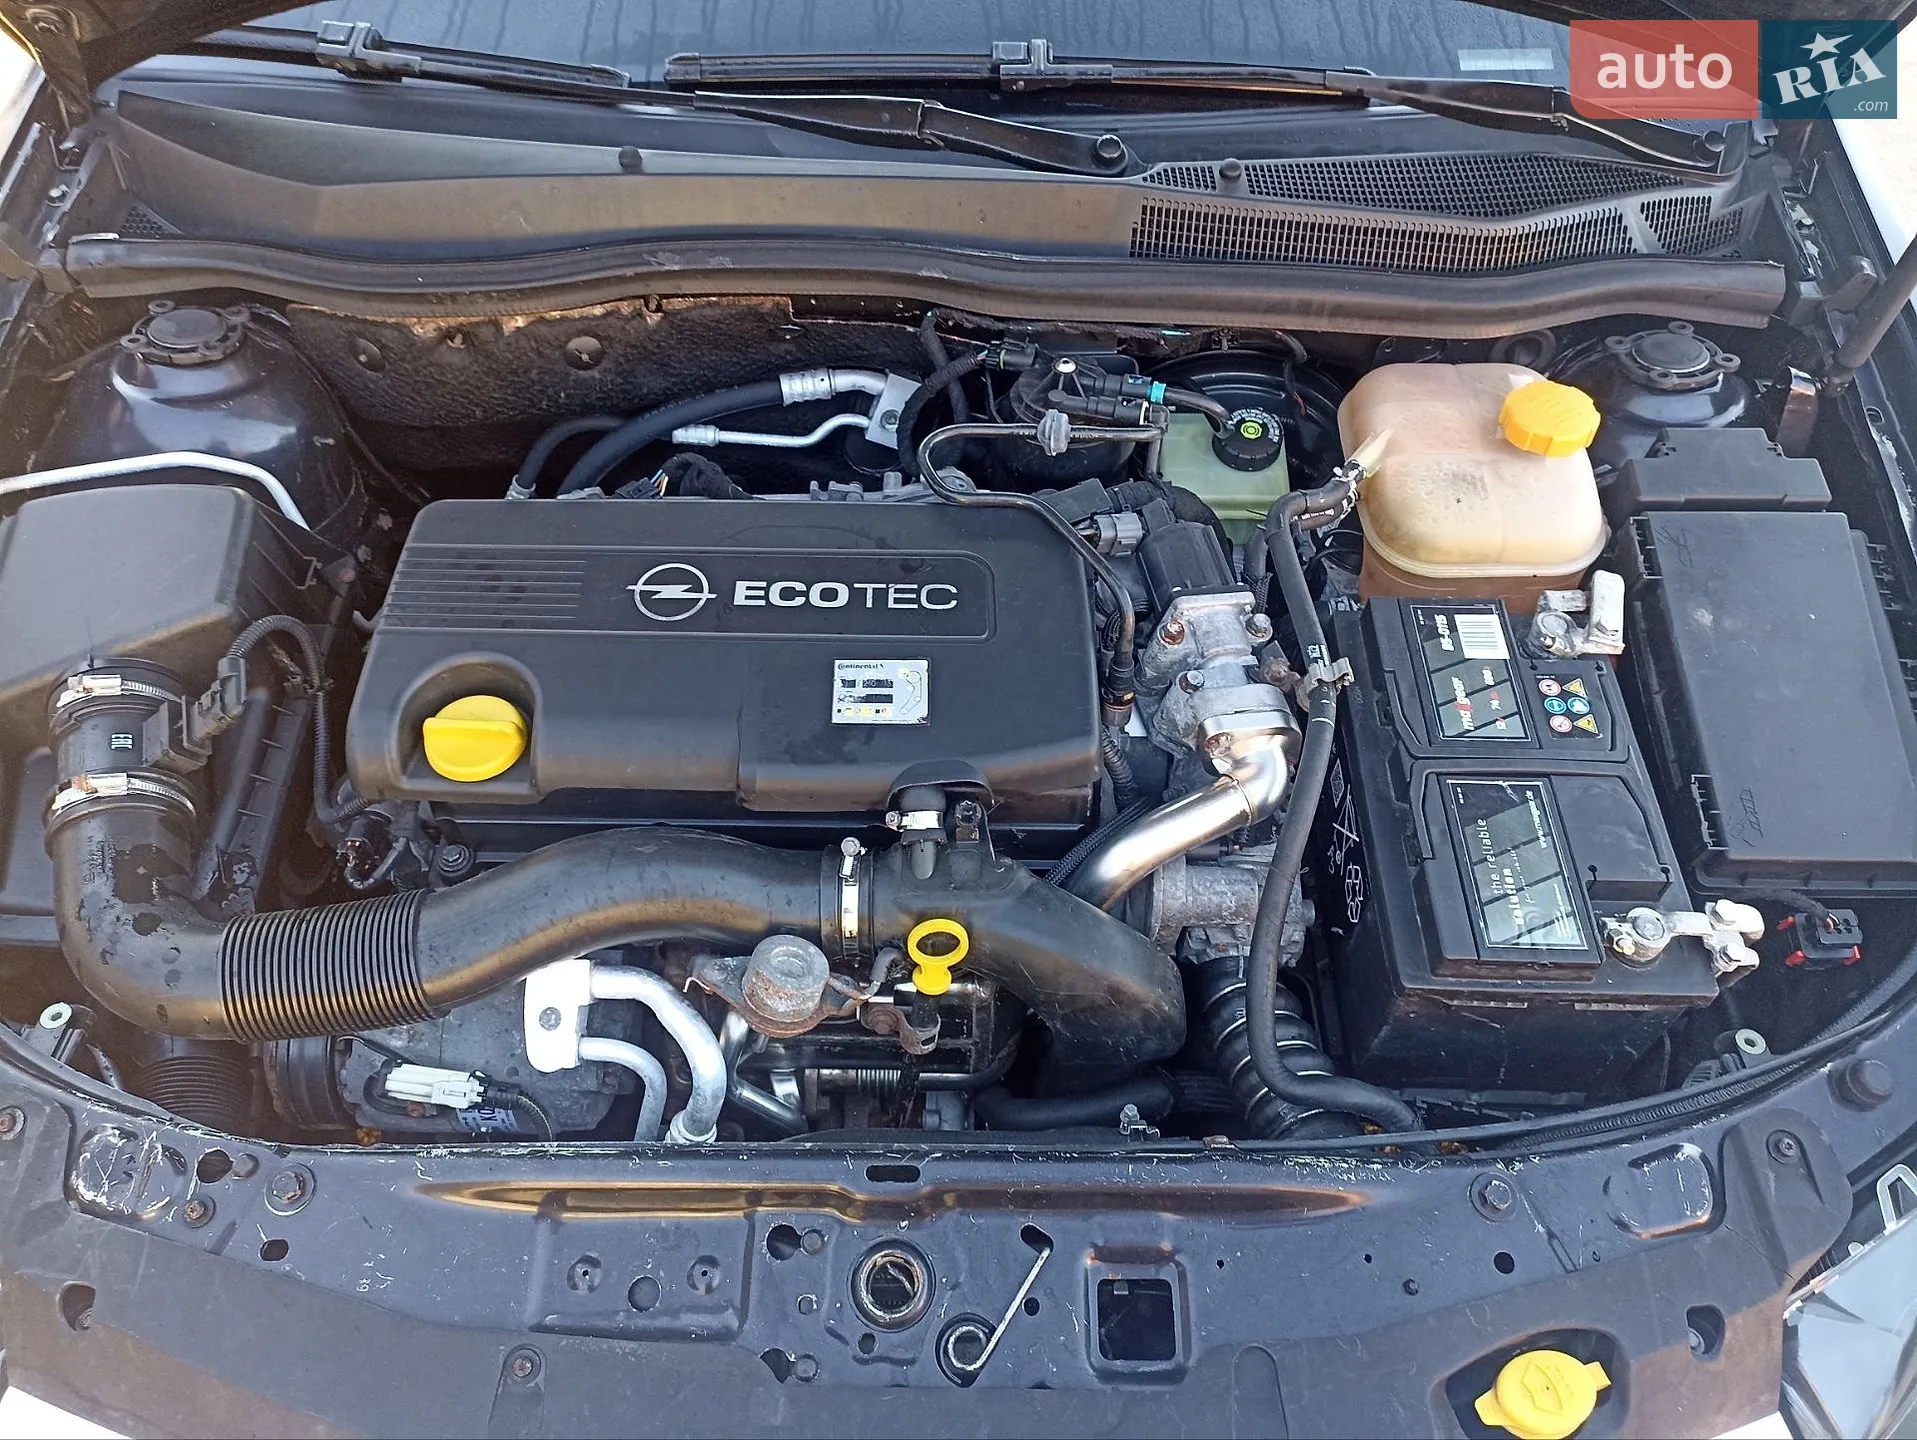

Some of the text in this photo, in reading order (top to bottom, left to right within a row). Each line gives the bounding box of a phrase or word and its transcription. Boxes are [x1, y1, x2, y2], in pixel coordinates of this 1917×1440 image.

[733, 581, 958, 610] ECOTEC
[1475, 818, 1504, 895] the reliable
[1501, 867, 1525, 926] solution
